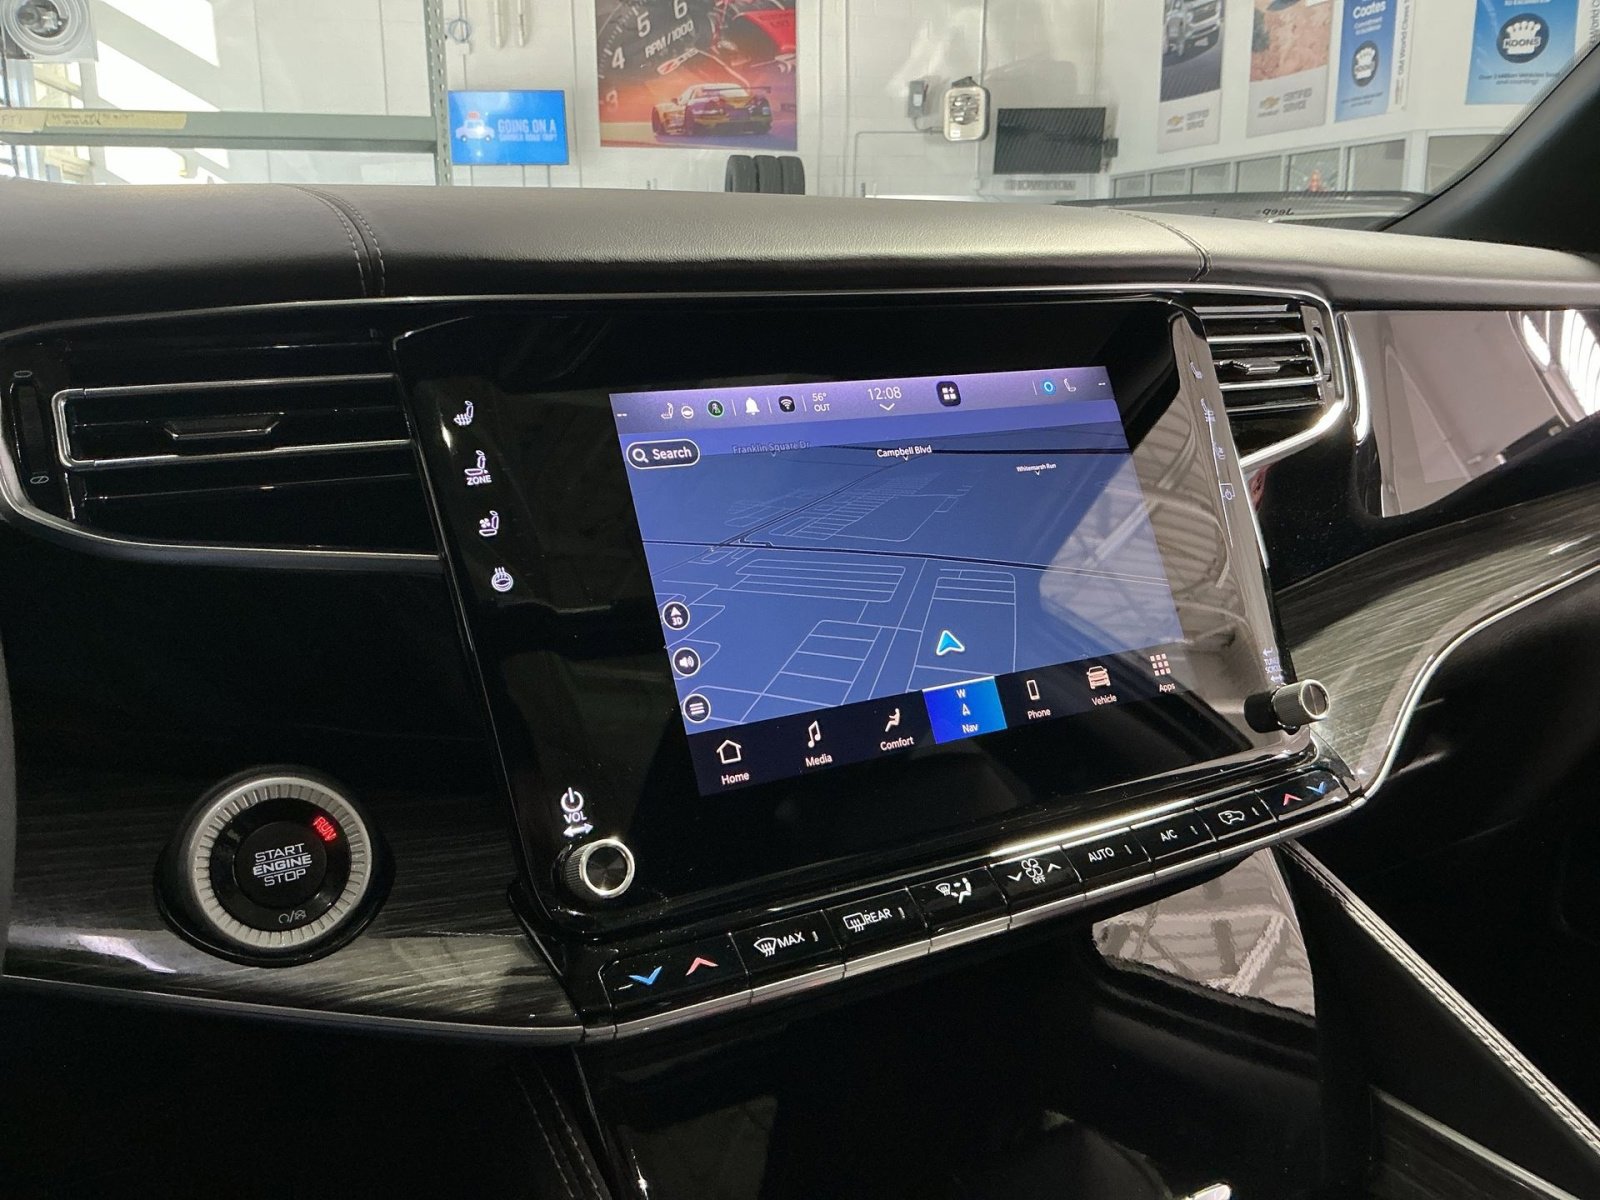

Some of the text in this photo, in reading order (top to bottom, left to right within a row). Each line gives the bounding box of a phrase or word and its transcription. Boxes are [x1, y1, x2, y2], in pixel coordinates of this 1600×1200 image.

[673, 0, 688, 19] 6
[1353, 1, 1386, 19] Coates
[637, 11, 650, 38] 5
[1504, 39, 1540, 47] KOONS
[612, 47, 625, 69] 4
[497, 118, 557, 133] GOING ON A
[812, 392, 827, 402] 56°
[867, 386, 902, 401] 12:08
[814, 403, 831, 412] OUT
[652, 446, 692, 460] Search
[732, 443, 768, 454] Franklin
[769, 441, 799, 452] Square
[877, 445, 932, 458] Campbell Blvd
[466, 474, 492, 485] ZONE
[672, 616, 683, 626] 3D
[956, 689, 966, 698] W
[1159, 682, 1176, 693] Apps
[1091, 694, 1117, 707] Vehicle
[1027, 708, 1051, 719] Phone
[962, 723, 979, 734] Nav
[880, 736, 914, 751] Comfort
[805, 754, 833, 767] Media
[721, 771, 750, 785] Home
[563, 811, 588, 824] VOL
[313, 816, 337, 842] RUN
[1159, 828, 1178, 842] A/C
[255, 843, 305, 863] START
[1087, 847, 1115, 863] AUTO
[253, 854, 312, 876] ENGINE
[264, 868, 306, 887] STOP
[1033, 874, 1046, 884] OFF
[865, 907, 893, 924] REAR
[776, 931, 805, 949] MAX
